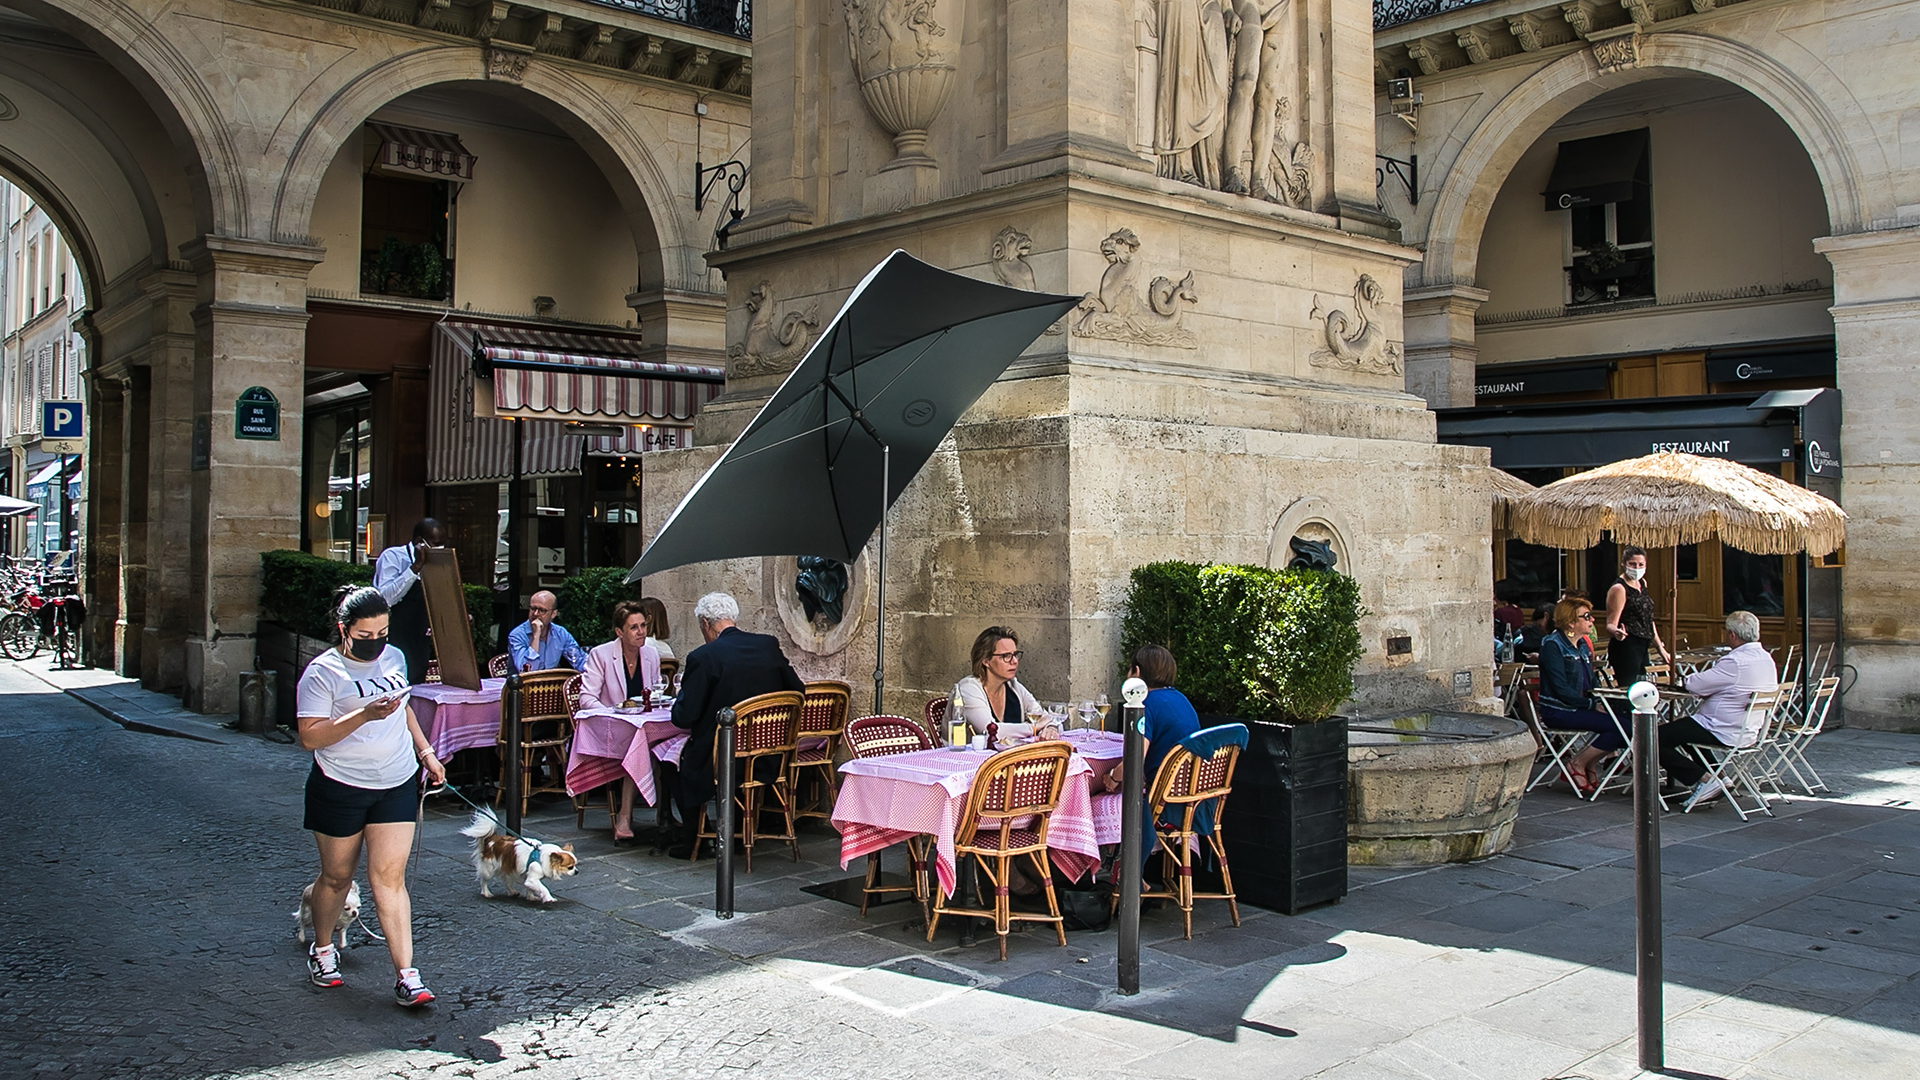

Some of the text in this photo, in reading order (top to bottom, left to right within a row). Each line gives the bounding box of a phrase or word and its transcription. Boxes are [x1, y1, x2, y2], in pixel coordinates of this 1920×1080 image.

[396, 152, 422, 164] TABLE
[1475, 381, 1525, 395] ESTAURANT
[54, 408, 73, 432] P
[1651, 440, 1731, 454] RESTAURANT
